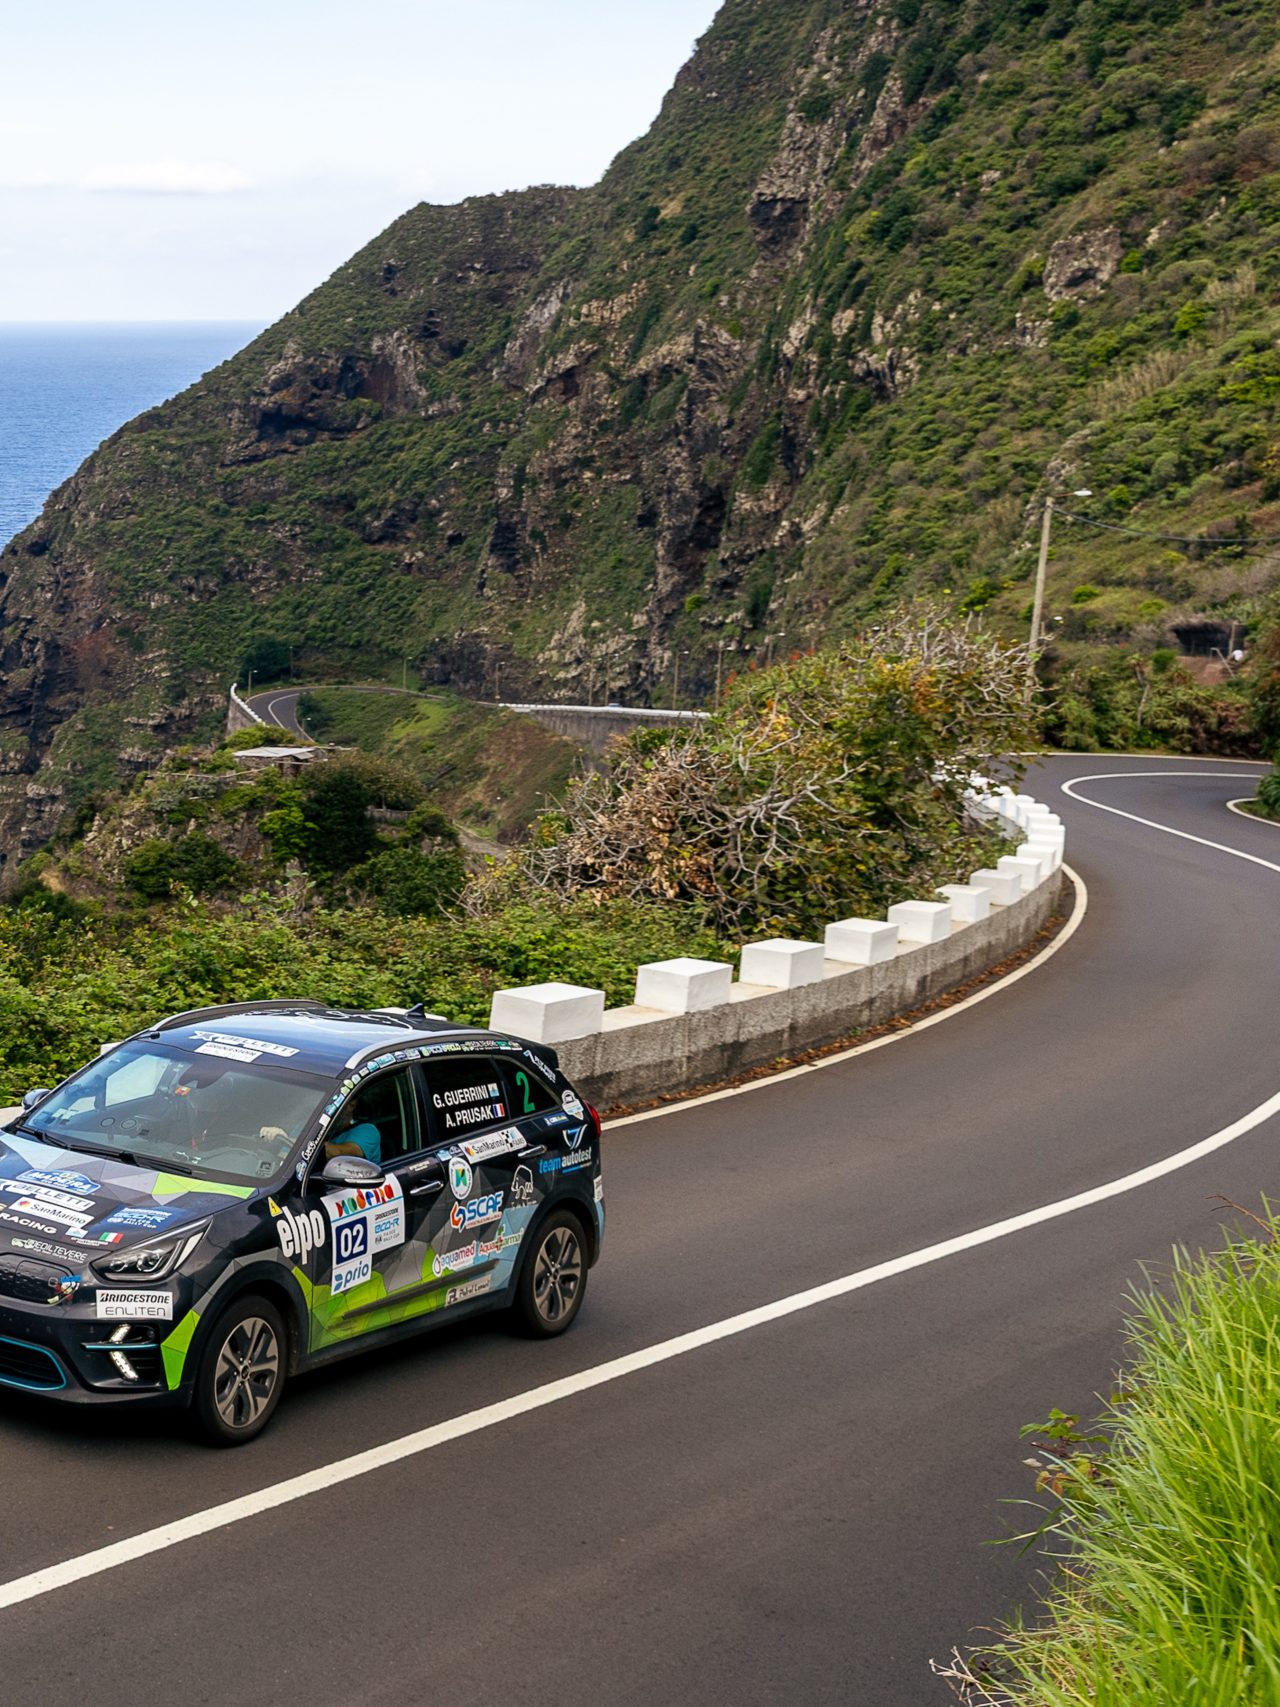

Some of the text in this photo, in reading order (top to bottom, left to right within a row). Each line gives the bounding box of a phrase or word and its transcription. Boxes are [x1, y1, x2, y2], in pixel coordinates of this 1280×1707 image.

[433, 1085, 489, 1108] G. GUERRINI
[516, 1072, 535, 1113] 2
[446, 1105, 494, 1128] A. PRUSAK
[539, 1146, 592, 1174] team autotest
[27, 1171, 91, 1189] MADEIRA
[30, 1203, 86, 1225] SanMarino
[466, 1192, 503, 1221] SCAF
[276, 1206, 325, 1265] elpo
[339, 1223, 365, 1259] 02
[441, 1245, 475, 1268] aquamed
[343, 1261, 369, 1287] prio
[100, 1293, 170, 1304] BRIDGESTONE
[105, 1306, 166, 1317] ENLITEN
